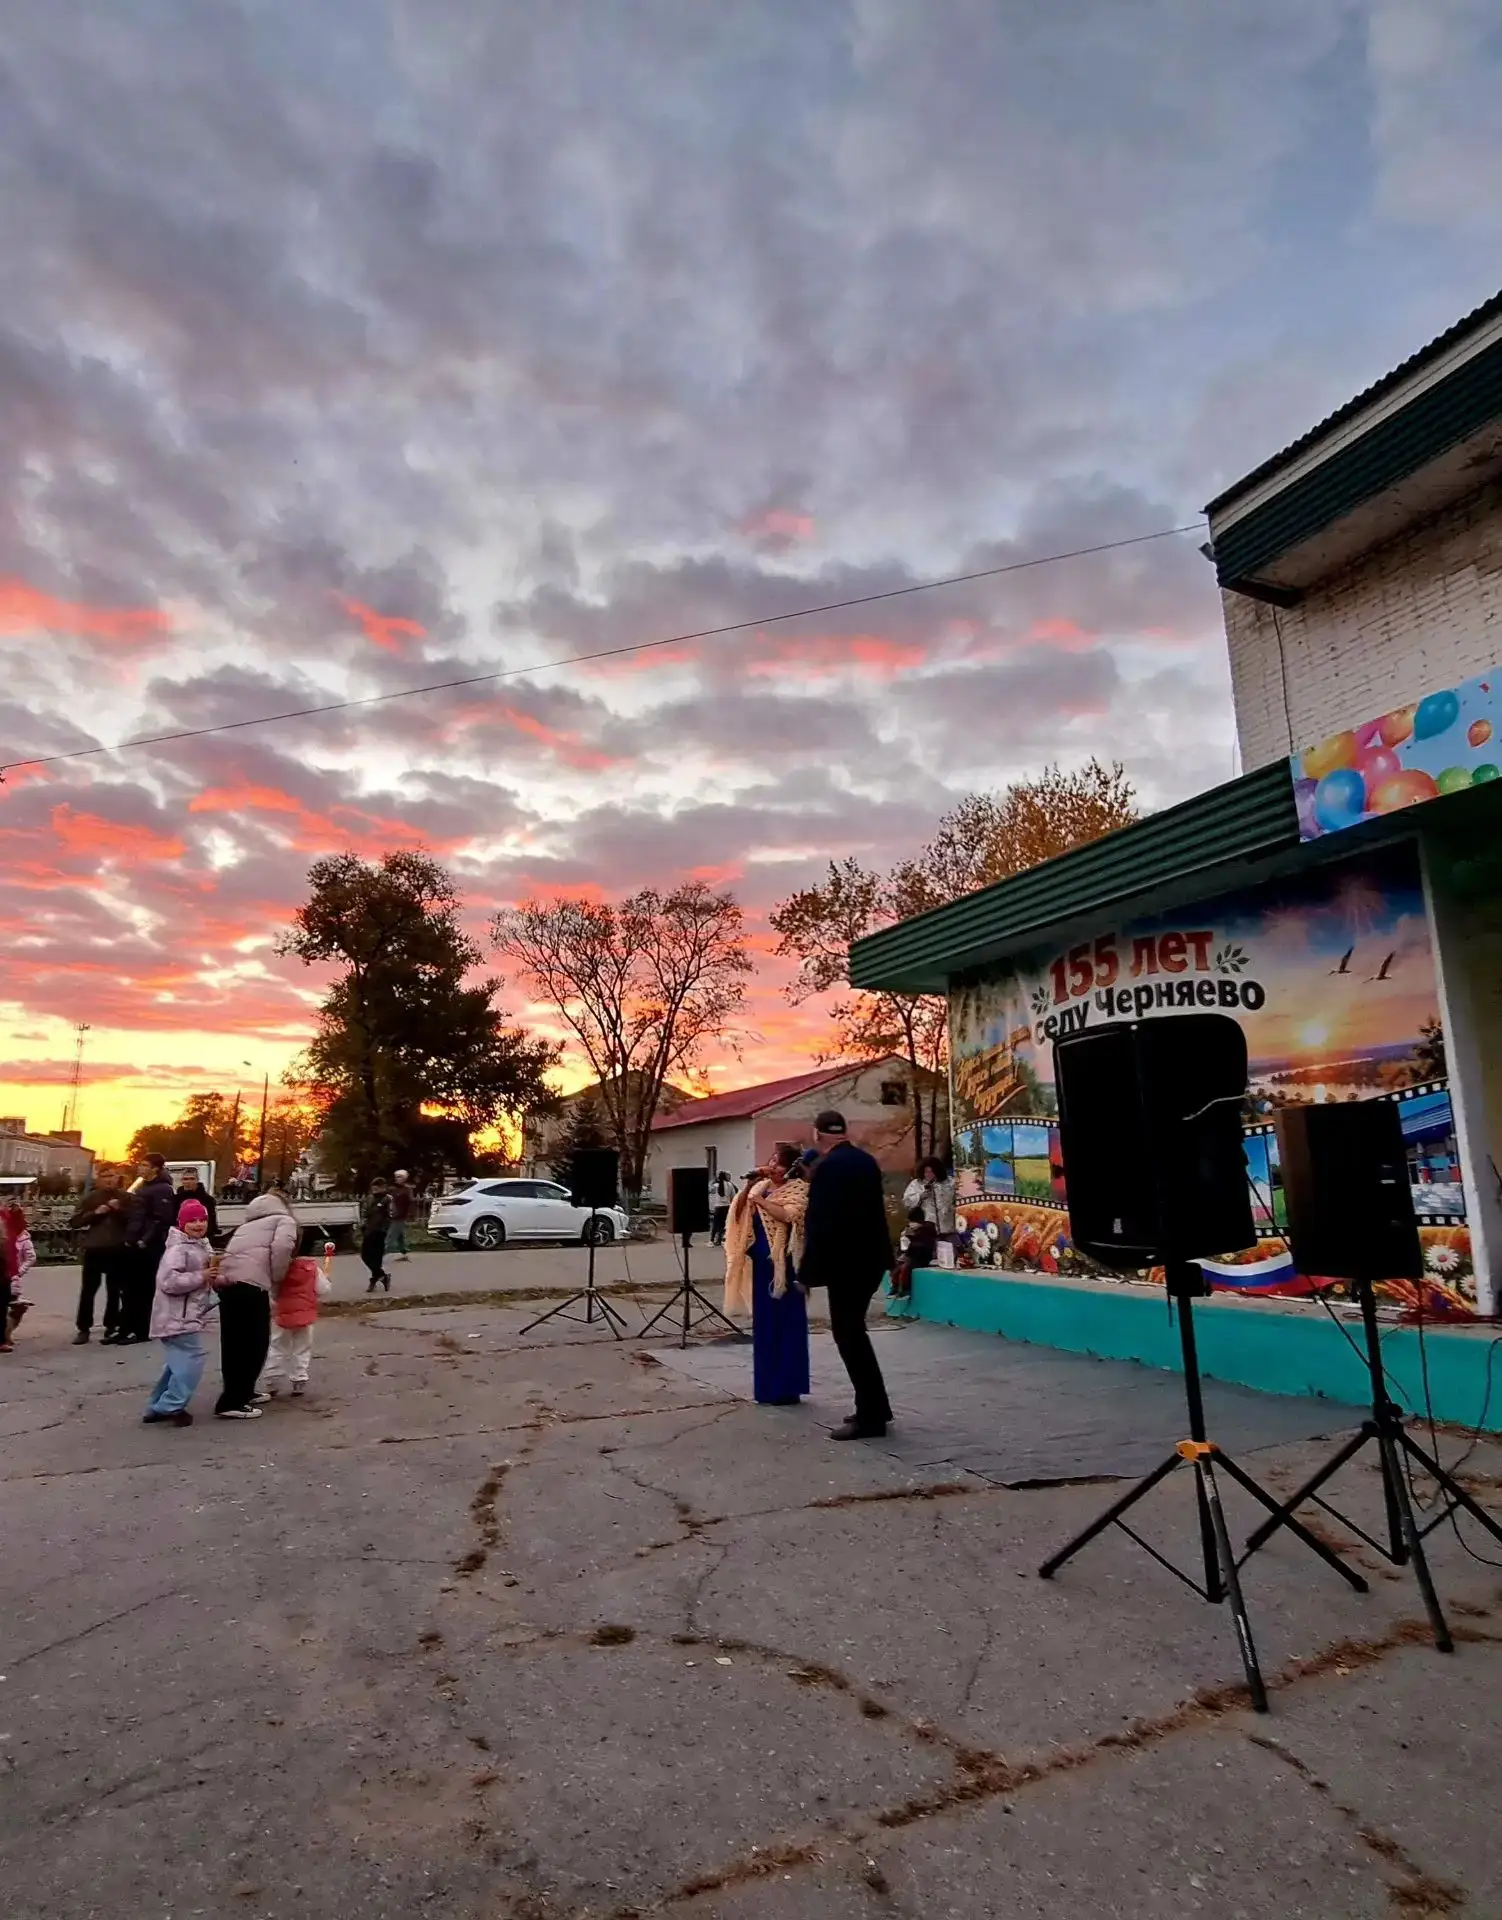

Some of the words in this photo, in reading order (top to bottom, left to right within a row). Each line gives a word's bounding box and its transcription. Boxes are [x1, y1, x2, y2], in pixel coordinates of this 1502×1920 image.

[1051, 933, 1119, 1005] 155
[1130, 931, 1213, 977] лет
[1033, 1000, 1089, 1045] селу
[1095, 979, 1265, 1017] Черняево
